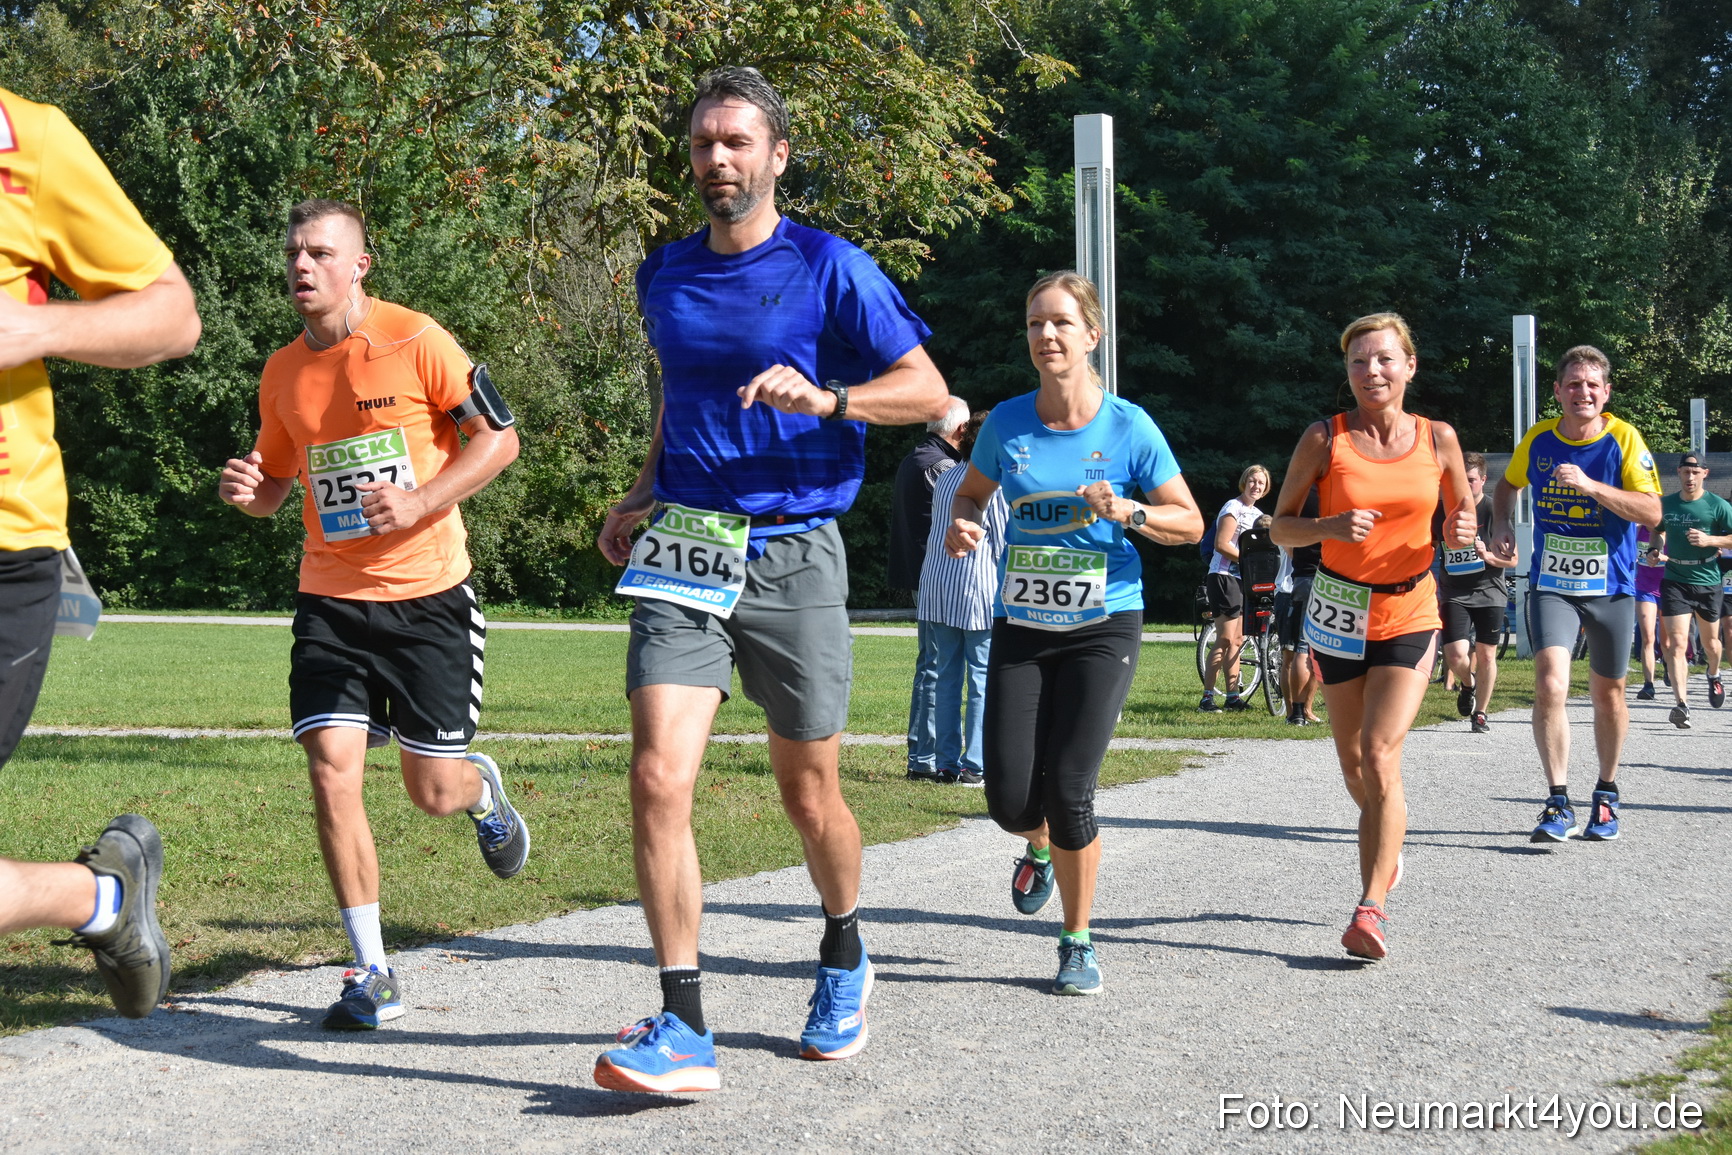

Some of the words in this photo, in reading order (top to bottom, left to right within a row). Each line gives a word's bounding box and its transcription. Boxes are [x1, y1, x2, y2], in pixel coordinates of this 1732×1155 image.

[356, 396, 396, 411] THULE
[311, 434, 397, 469] BOCK
[1084, 469, 1105, 480] TUM
[1009, 500, 1100, 526] LAUF10
[660, 510, 735, 543] OCK
[1548, 537, 1601, 553] BOCK
[643, 536, 732, 582] 2164
[1014, 551, 1096, 573] BOCK
[1449, 551, 1478, 563] 2823
[1548, 555, 1600, 576] 2490
[631, 573, 726, 603] BERNHARD
[1013, 578, 1091, 608] 2367
[1313, 573, 1363, 607] OCK
[1555, 579, 1588, 589] PETER
[1026, 610, 1083, 624] NICOLE
[1306, 624, 1343, 648] INGRID
